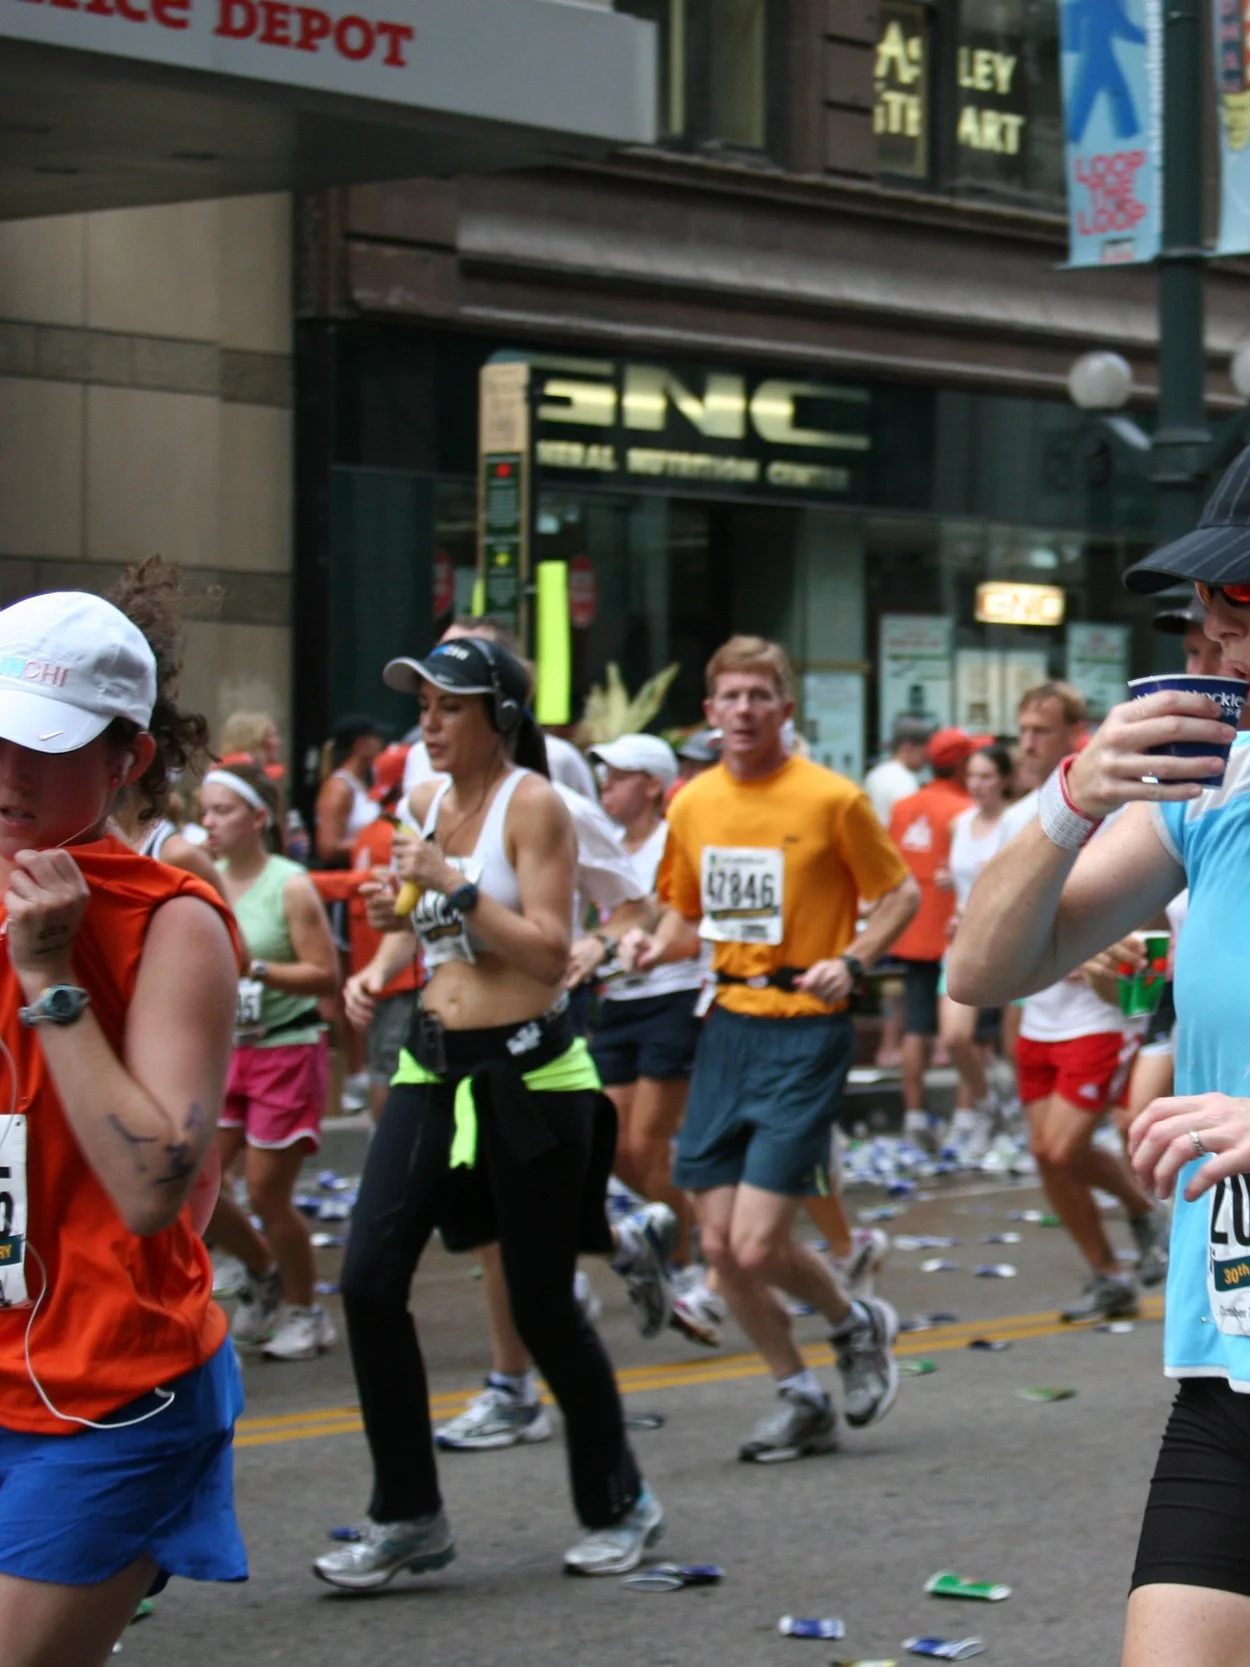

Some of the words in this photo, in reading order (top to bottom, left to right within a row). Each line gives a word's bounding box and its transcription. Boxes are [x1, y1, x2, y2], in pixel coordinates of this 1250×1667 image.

[213, 0, 414, 67] DEPOT
[1073, 149, 1146, 186] LOOP
[1077, 203, 1147, 235] LOOP
[1223, 1264, 1250, 1285] 30th
